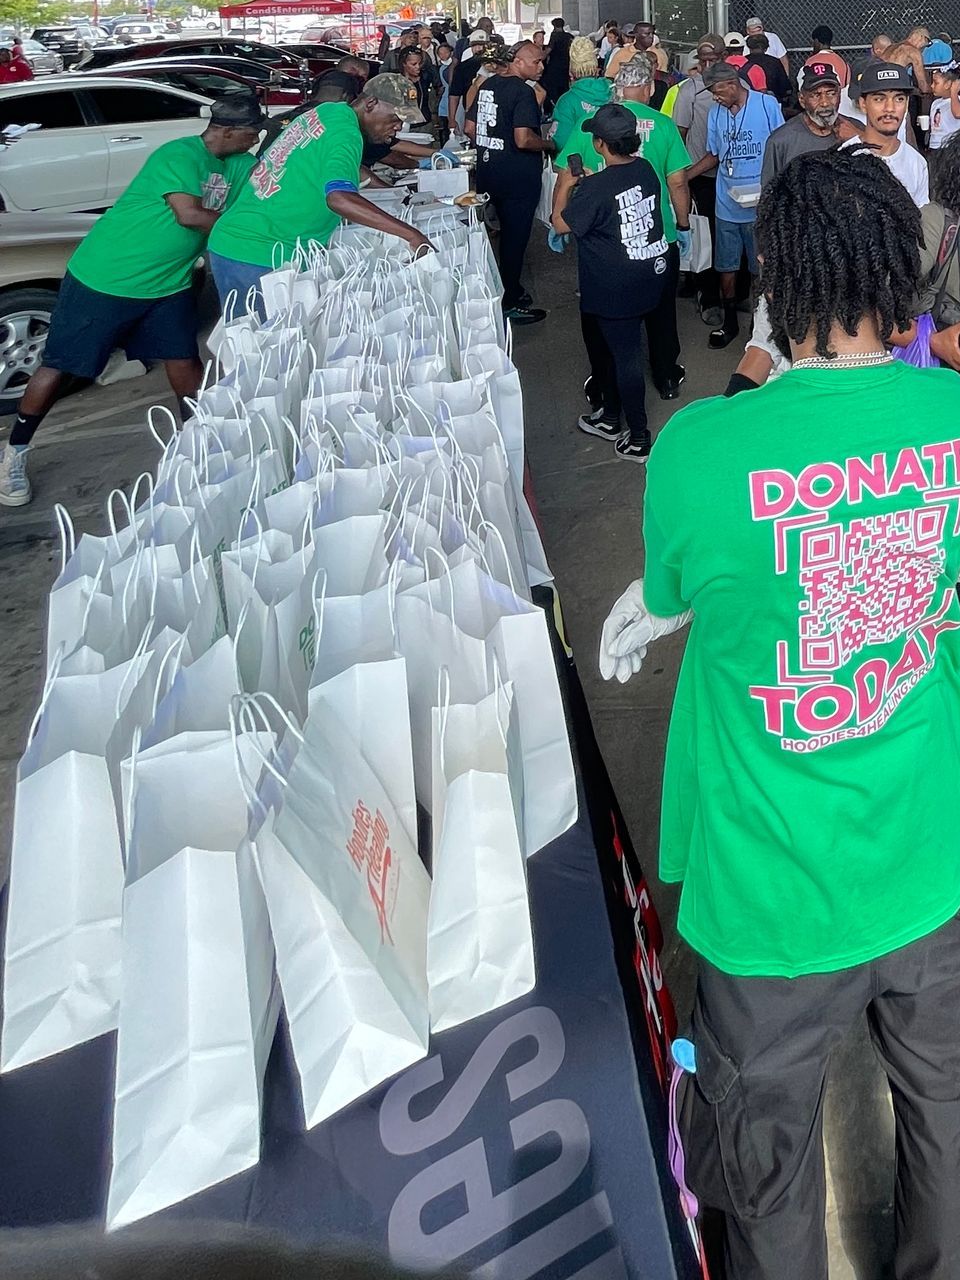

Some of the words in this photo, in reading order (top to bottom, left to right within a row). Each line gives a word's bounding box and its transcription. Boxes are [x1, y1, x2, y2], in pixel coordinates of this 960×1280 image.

[245, 6, 331, 15] CandSEnterprises
[878, 71, 899, 79] VANS
[731, 141, 762, 156] Healing
[615, 185, 643, 210] THIS
[620, 213, 655, 239] HELPS
[621, 232, 649, 249] THE
[780, 659, 936, 753] HOODIES4HEALING.ORG
